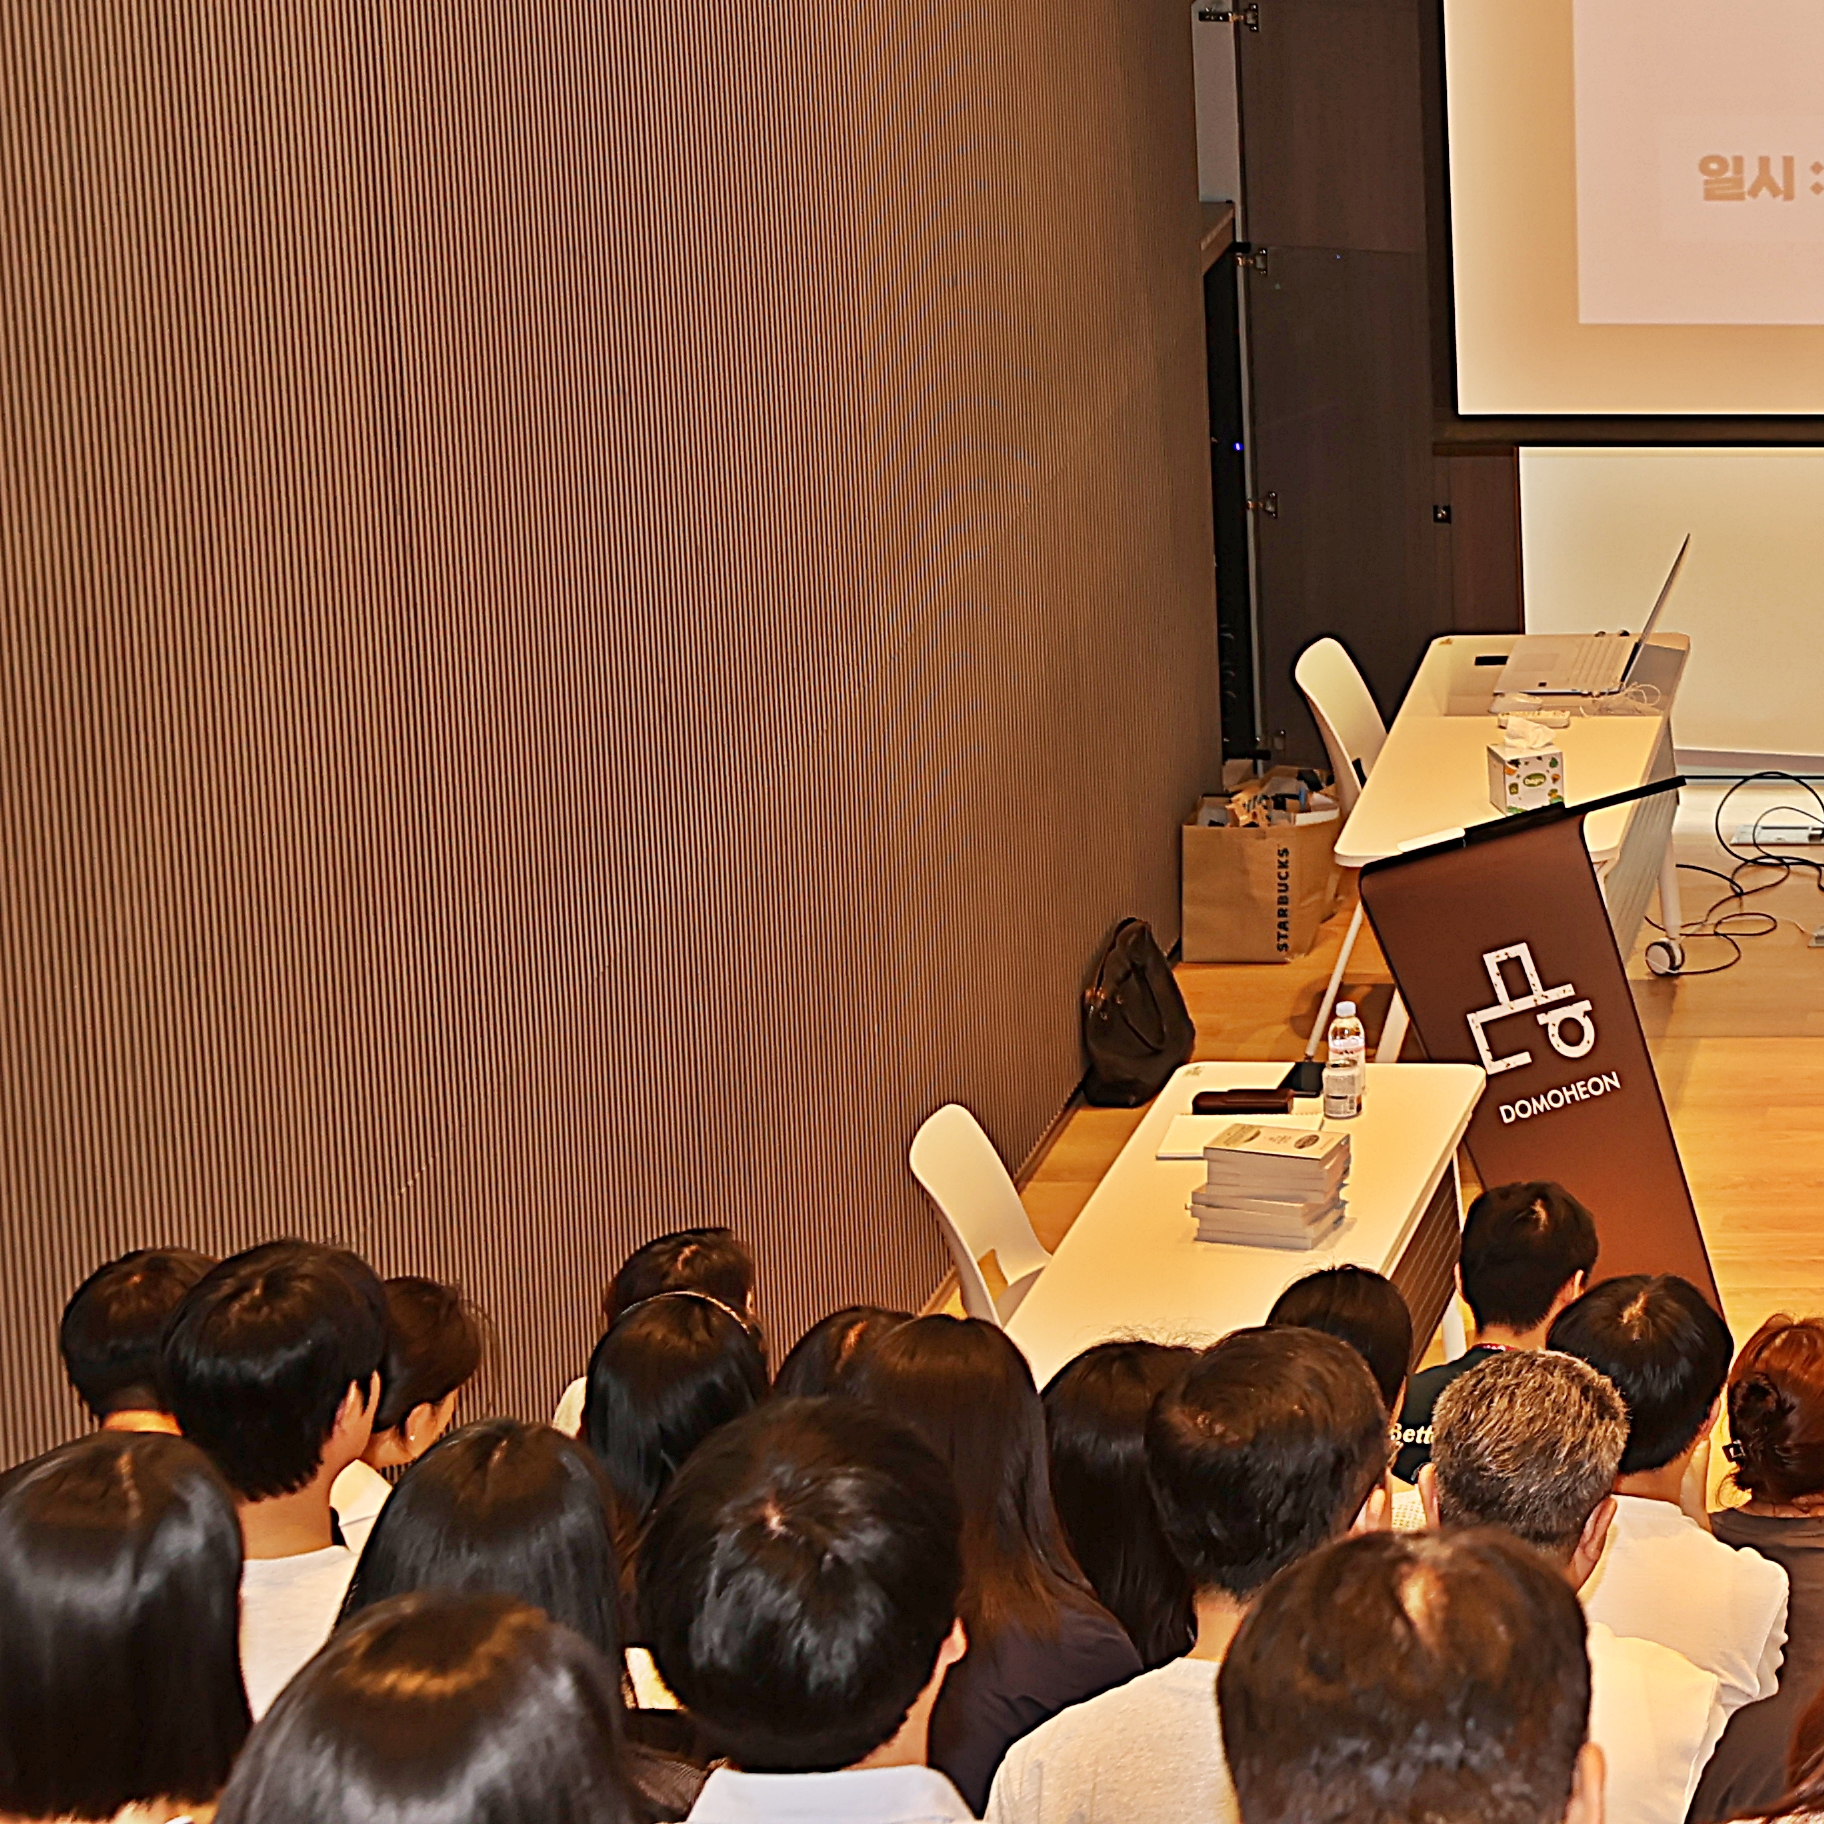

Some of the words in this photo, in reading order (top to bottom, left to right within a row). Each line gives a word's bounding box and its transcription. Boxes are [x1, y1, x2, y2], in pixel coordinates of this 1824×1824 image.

[1697, 154, 1796, 202] 일시
[1276, 847, 1290, 952] STARBUCKS
[1499, 1070, 1621, 1124] DOMOHEON
[1390, 1422, 1435, 1445] Bett
